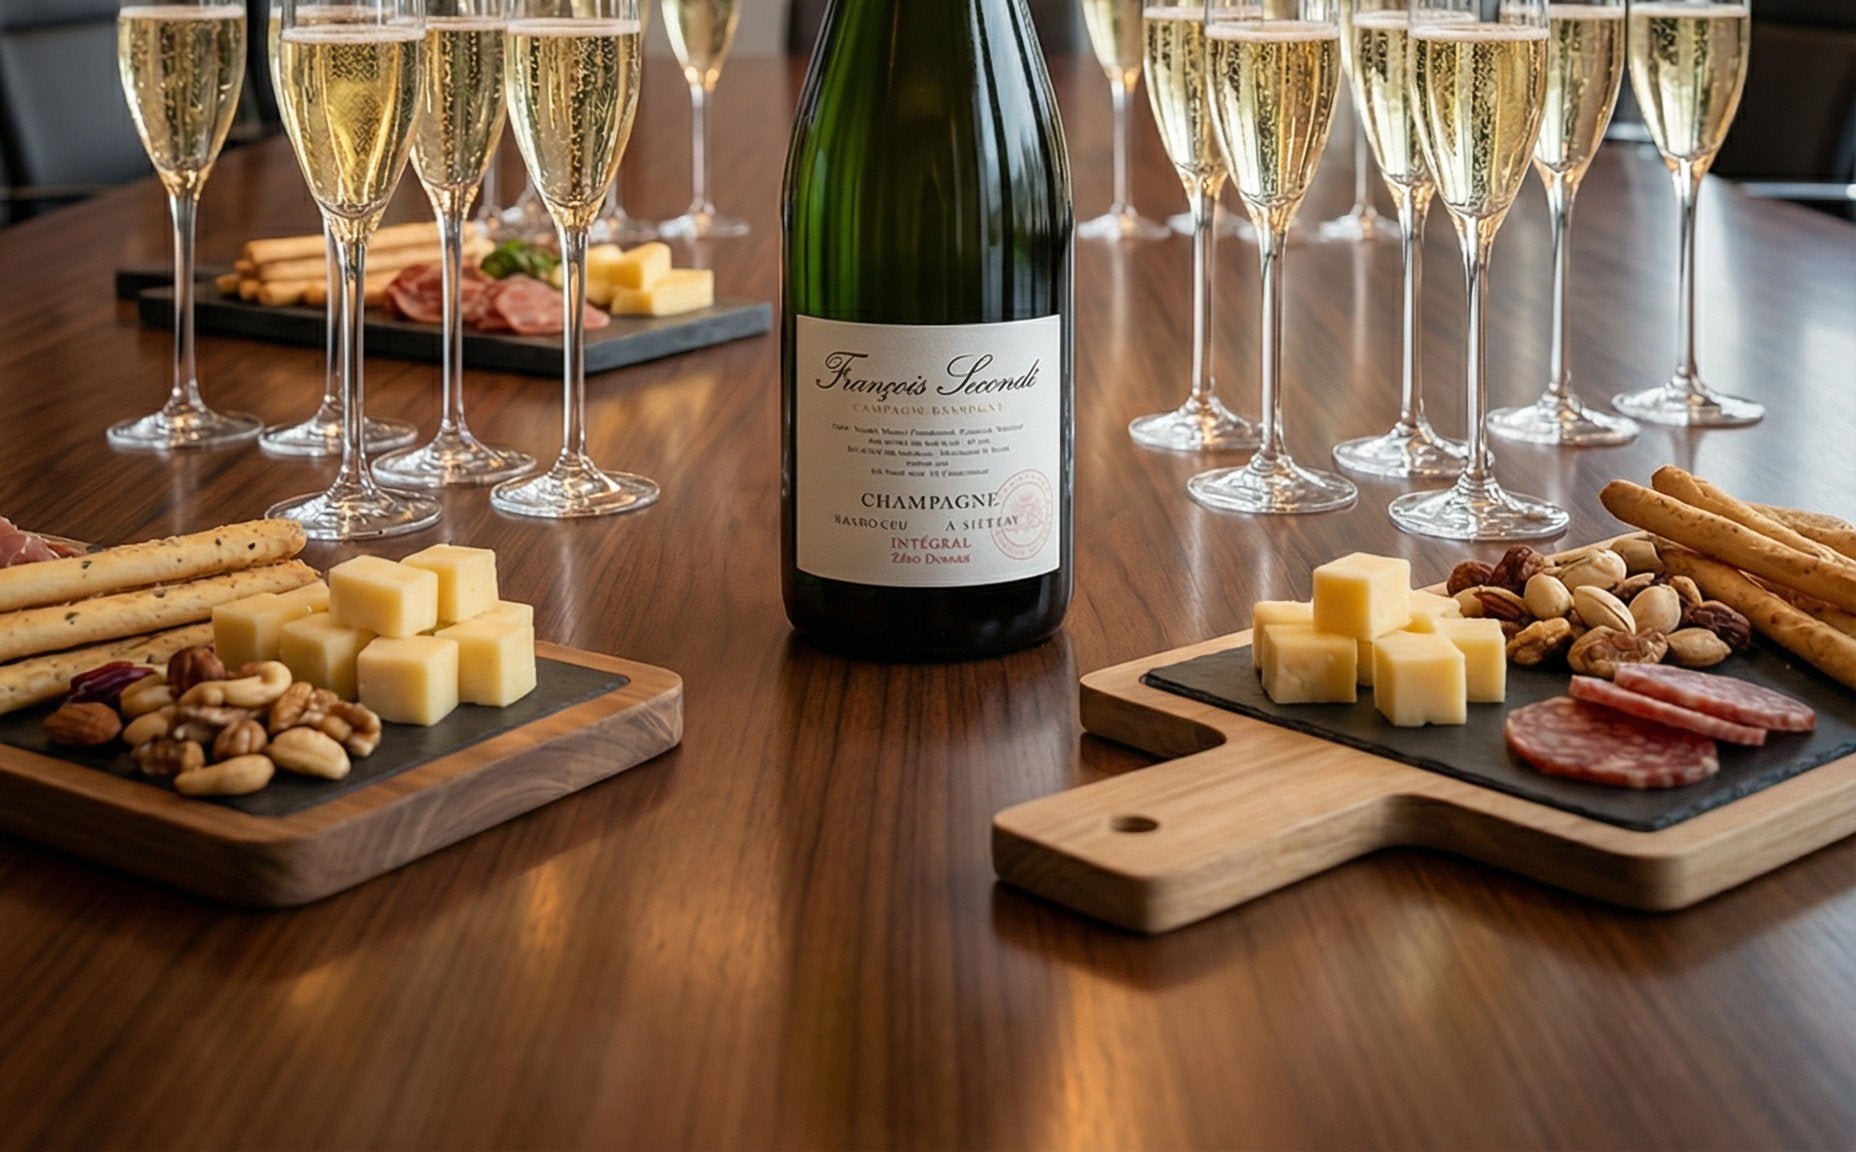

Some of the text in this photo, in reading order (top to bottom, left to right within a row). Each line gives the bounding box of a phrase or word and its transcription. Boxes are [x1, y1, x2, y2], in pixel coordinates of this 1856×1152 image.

[815, 351, 1041, 402] François Secondi
[861, 492, 1000, 510] CHAMPAGNE
[891, 534, 972, 551] INTÉGRAL
